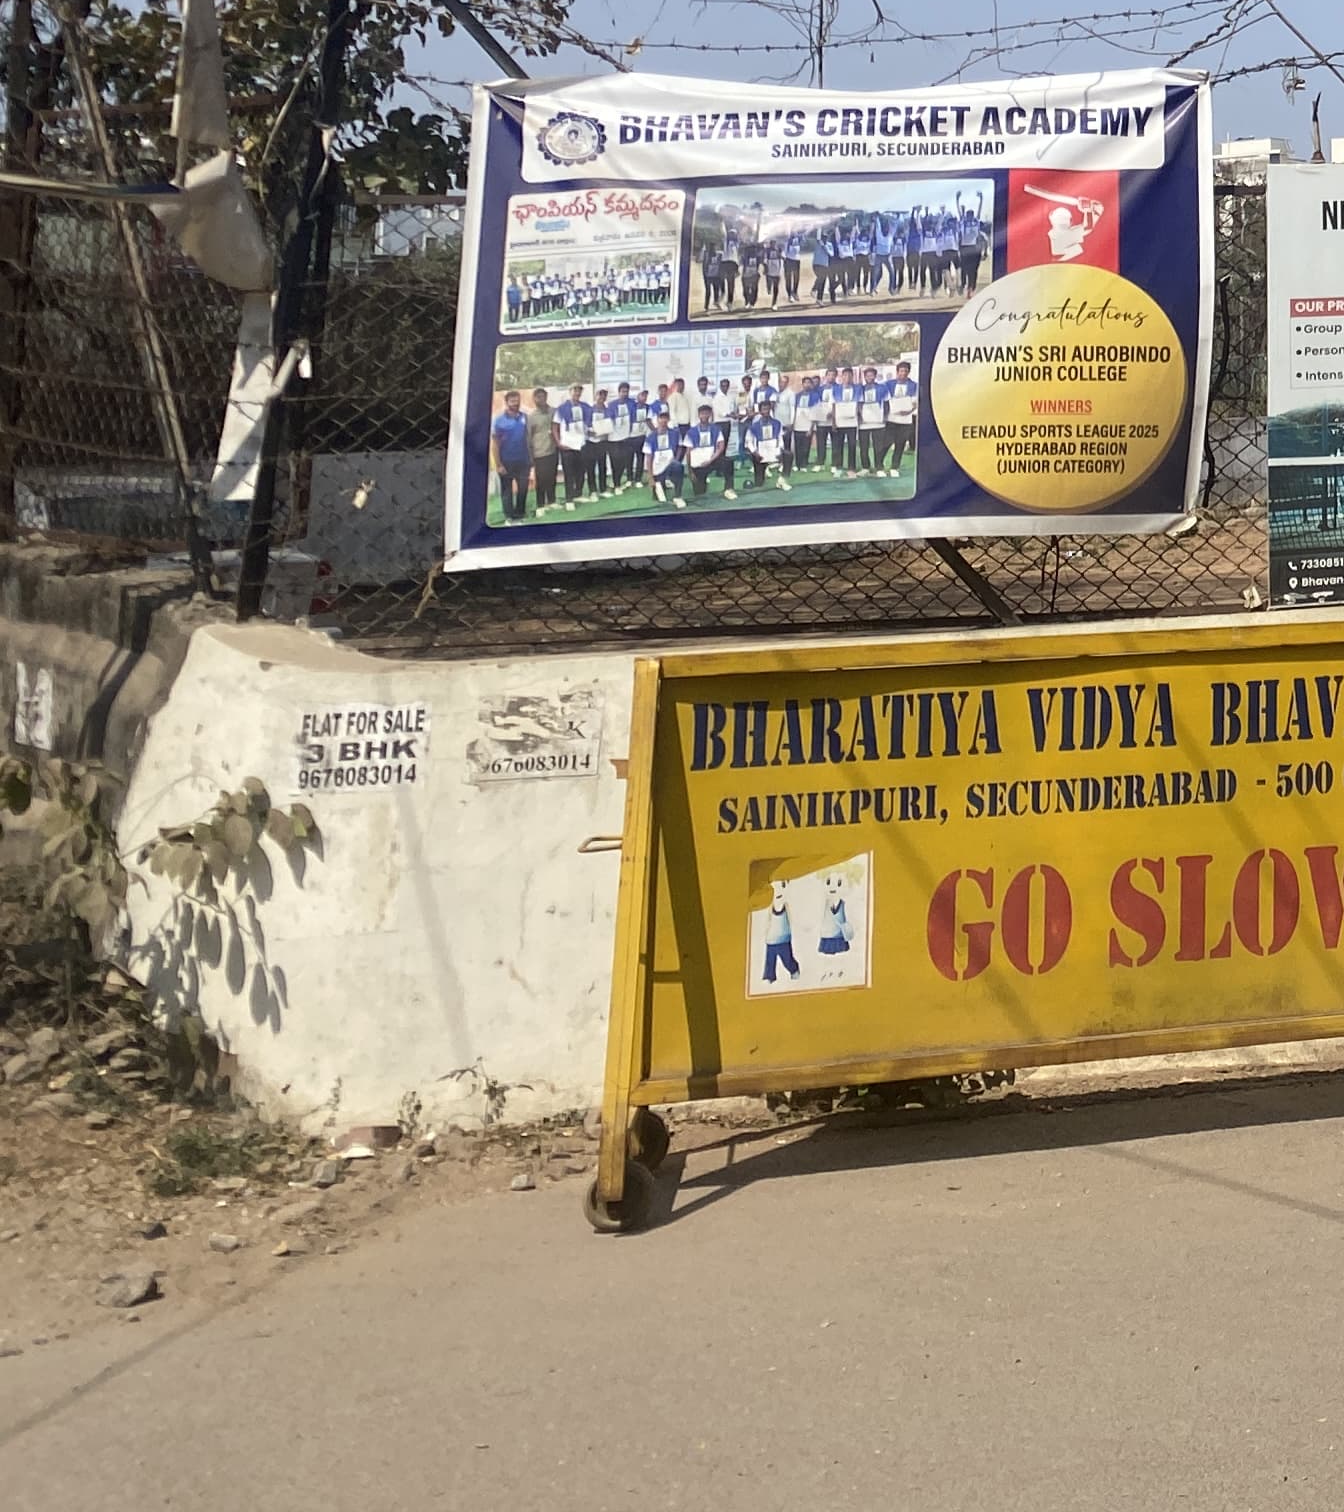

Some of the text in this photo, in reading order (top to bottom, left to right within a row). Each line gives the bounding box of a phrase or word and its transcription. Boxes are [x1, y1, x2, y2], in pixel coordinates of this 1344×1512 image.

[620, 106, 1153, 145] BHAVAN'S CRICKET ACADEMY
[771, 141, 1005, 158] SAINIKPURI, SECUNDERABAD
[974, 297, 1149, 333] Congratulations
[1295, 302, 1325, 313] OUR
[1304, 324, 1342, 334] Group
[947, 346, 1170, 363] BHAVAN'S SRI AUROBINDO
[994, 366, 1127, 382] JUNIOR COLLEGE
[1030, 400, 1092, 415] WINNERS
[962, 425, 1158, 439] EENADU SPORTS LEAGUE 2025
[996, 443, 1127, 456] HYDERABAD REGION
[997, 460, 1125, 475] (JUNIOR CATEGORY)
[301, 709, 425, 737] FLAT FOR SALE
[690, 688, 1002, 772] BHARATIYA
[1026, 682, 1179, 754] VIDYA
[303, 739, 417, 763] 3 BHK
[716, 785, 948, 835] SAINIKPURI,
[965, 768, 1238, 819] SECUNDERABAD
[1276, 761, 1337, 798] 500
[926, 863, 1073, 982] GO
